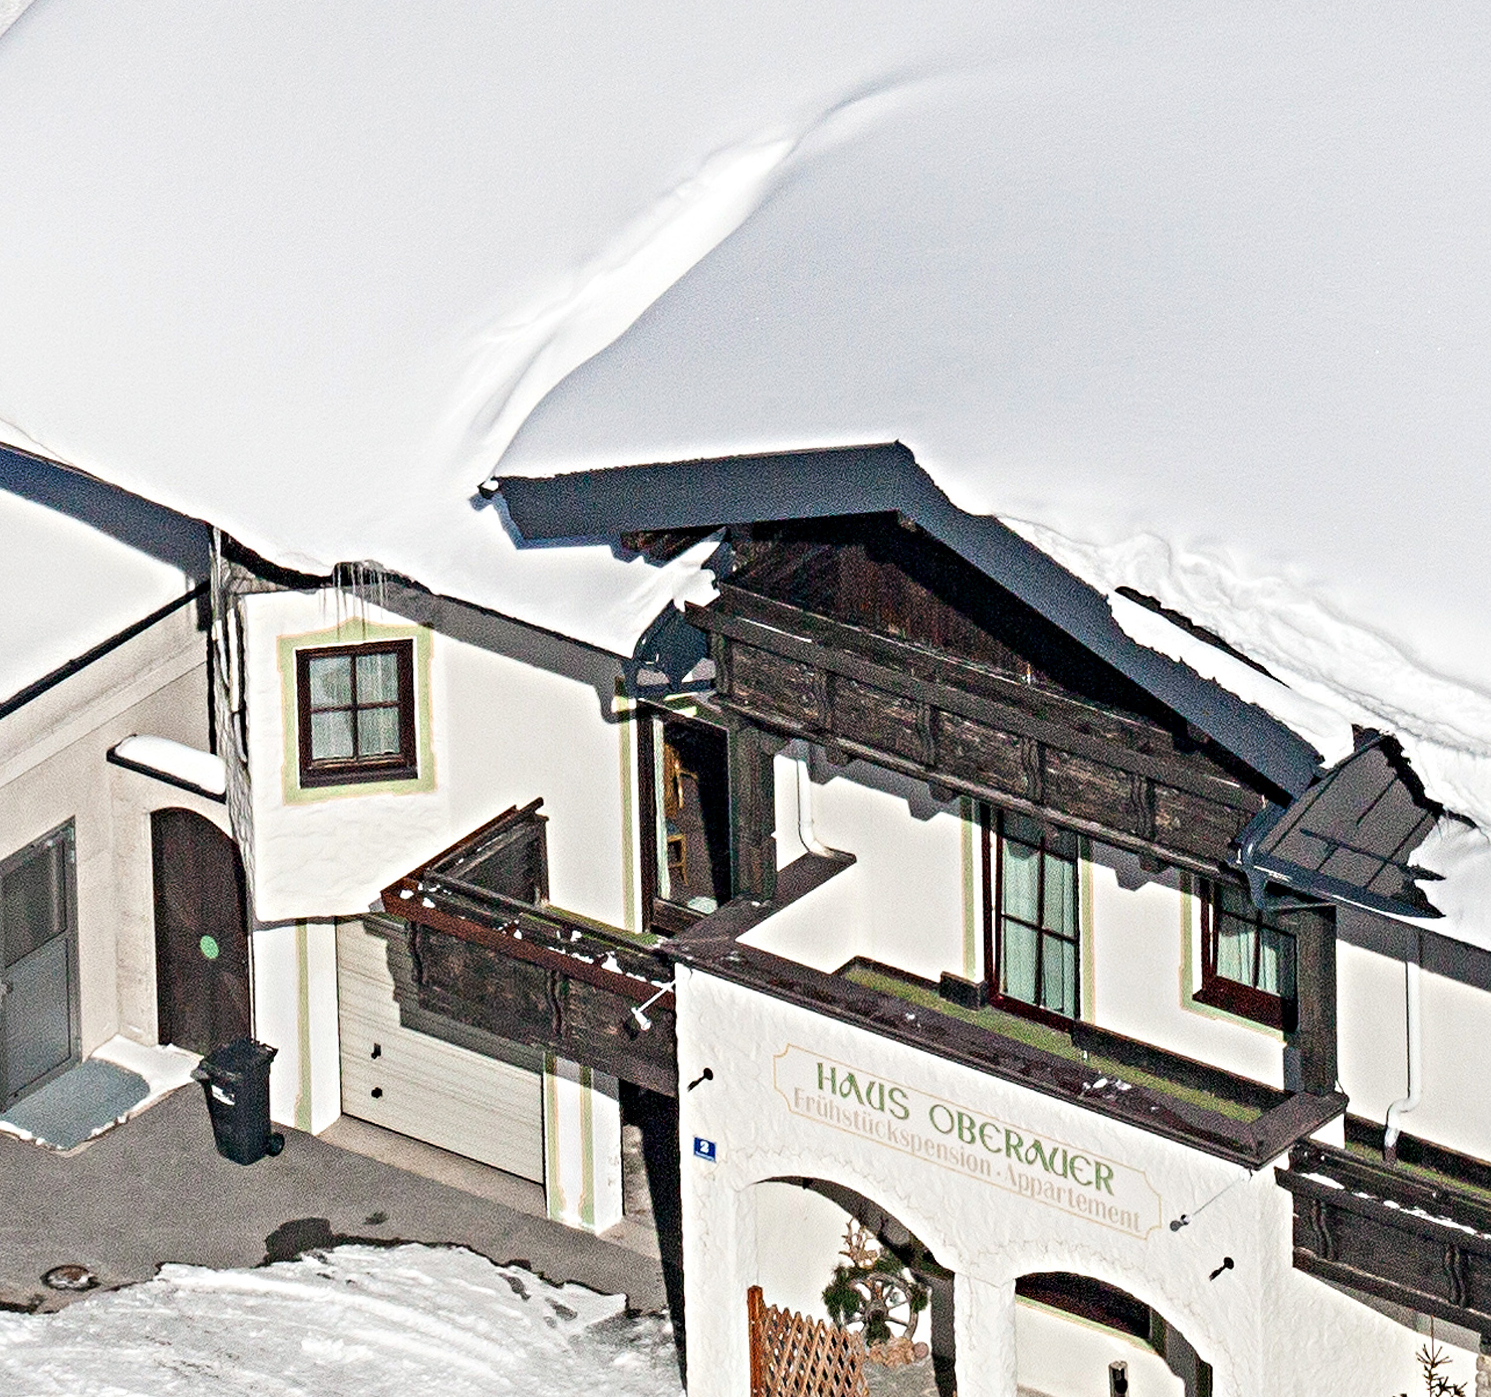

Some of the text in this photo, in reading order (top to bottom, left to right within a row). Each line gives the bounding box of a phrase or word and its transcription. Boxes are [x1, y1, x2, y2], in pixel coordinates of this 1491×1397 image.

[794, 1086, 1141, 1233] Frühstückspension Appartement
[817, 1062, 1115, 1197] HAUS OBERAUER
